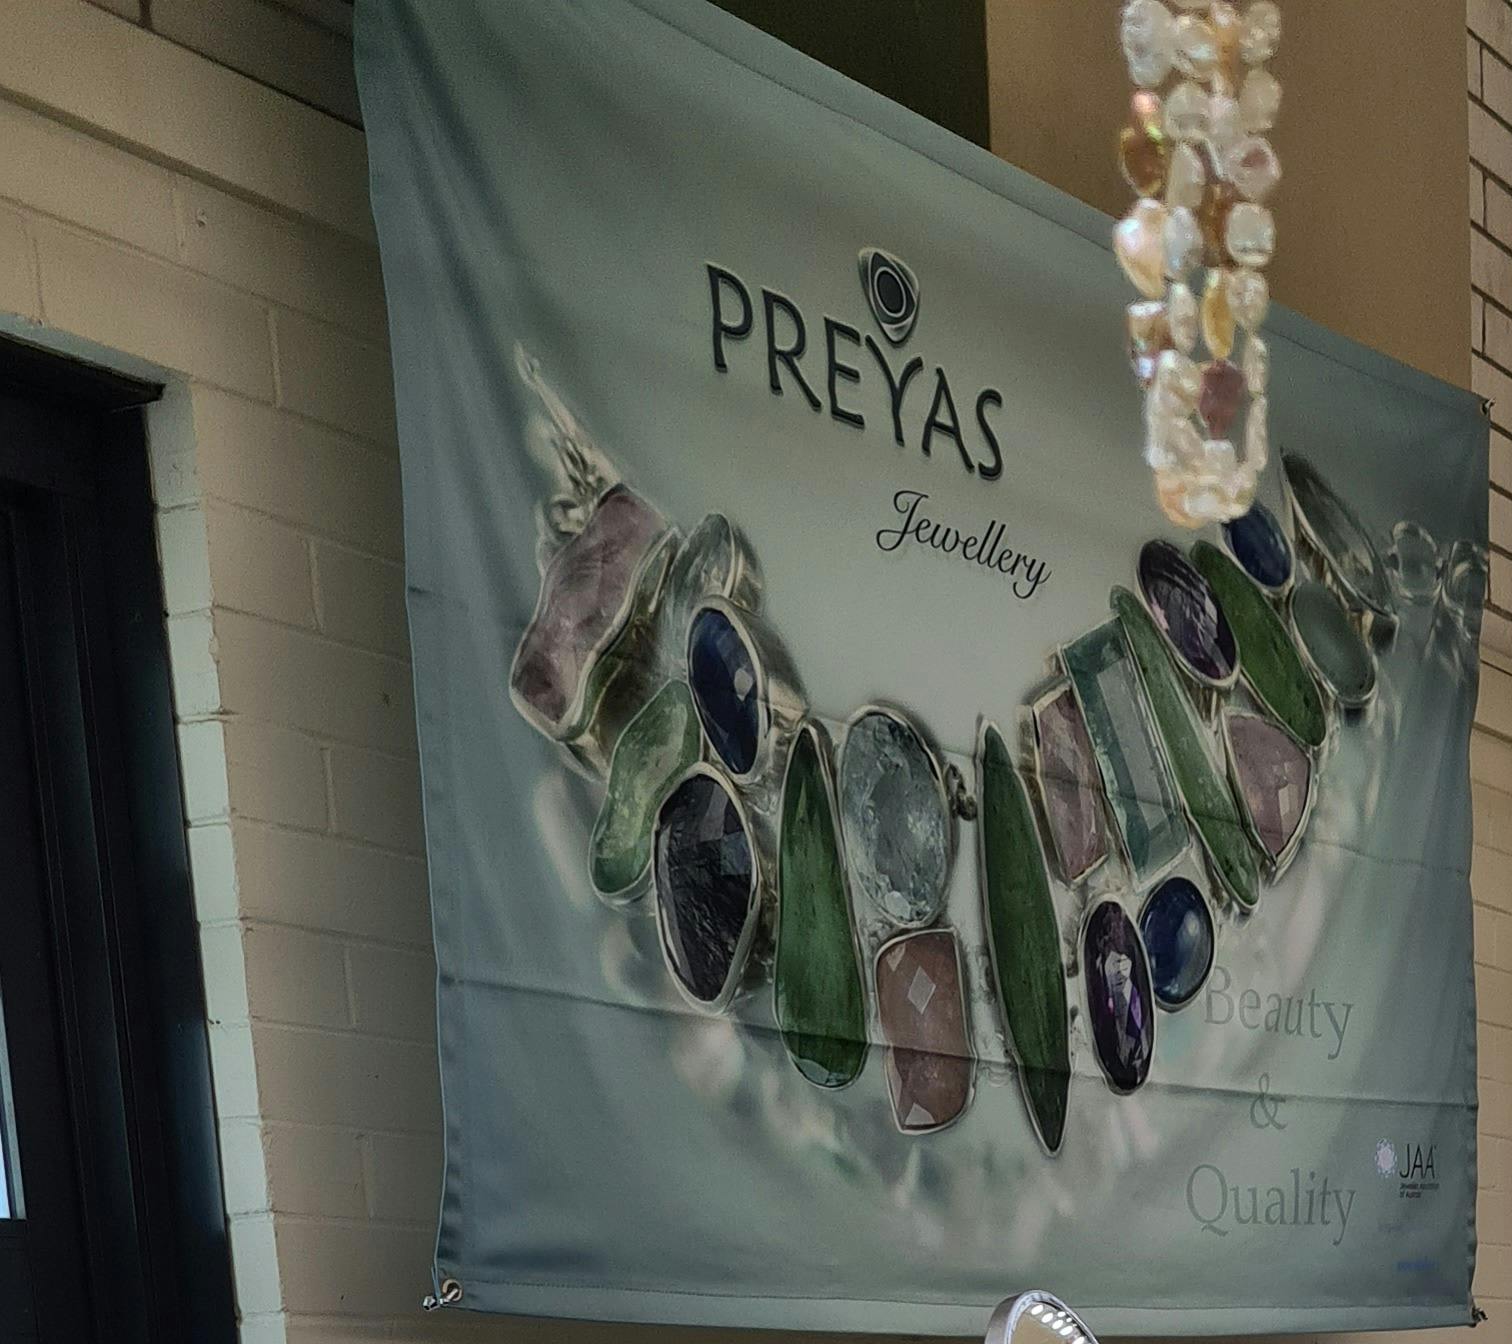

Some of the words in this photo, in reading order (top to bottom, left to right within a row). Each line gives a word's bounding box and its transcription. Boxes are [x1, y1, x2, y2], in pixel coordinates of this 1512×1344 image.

[706, 262, 1003, 480] PREYAS
[876, 489, 1052, 599] Jewellery
[1203, 965, 1354, 1060] Beauty
[1249, 1072, 1288, 1130] &
[1186, 1163, 1357, 1246] Quality
[1399, 1143, 1435, 1179] JAA
